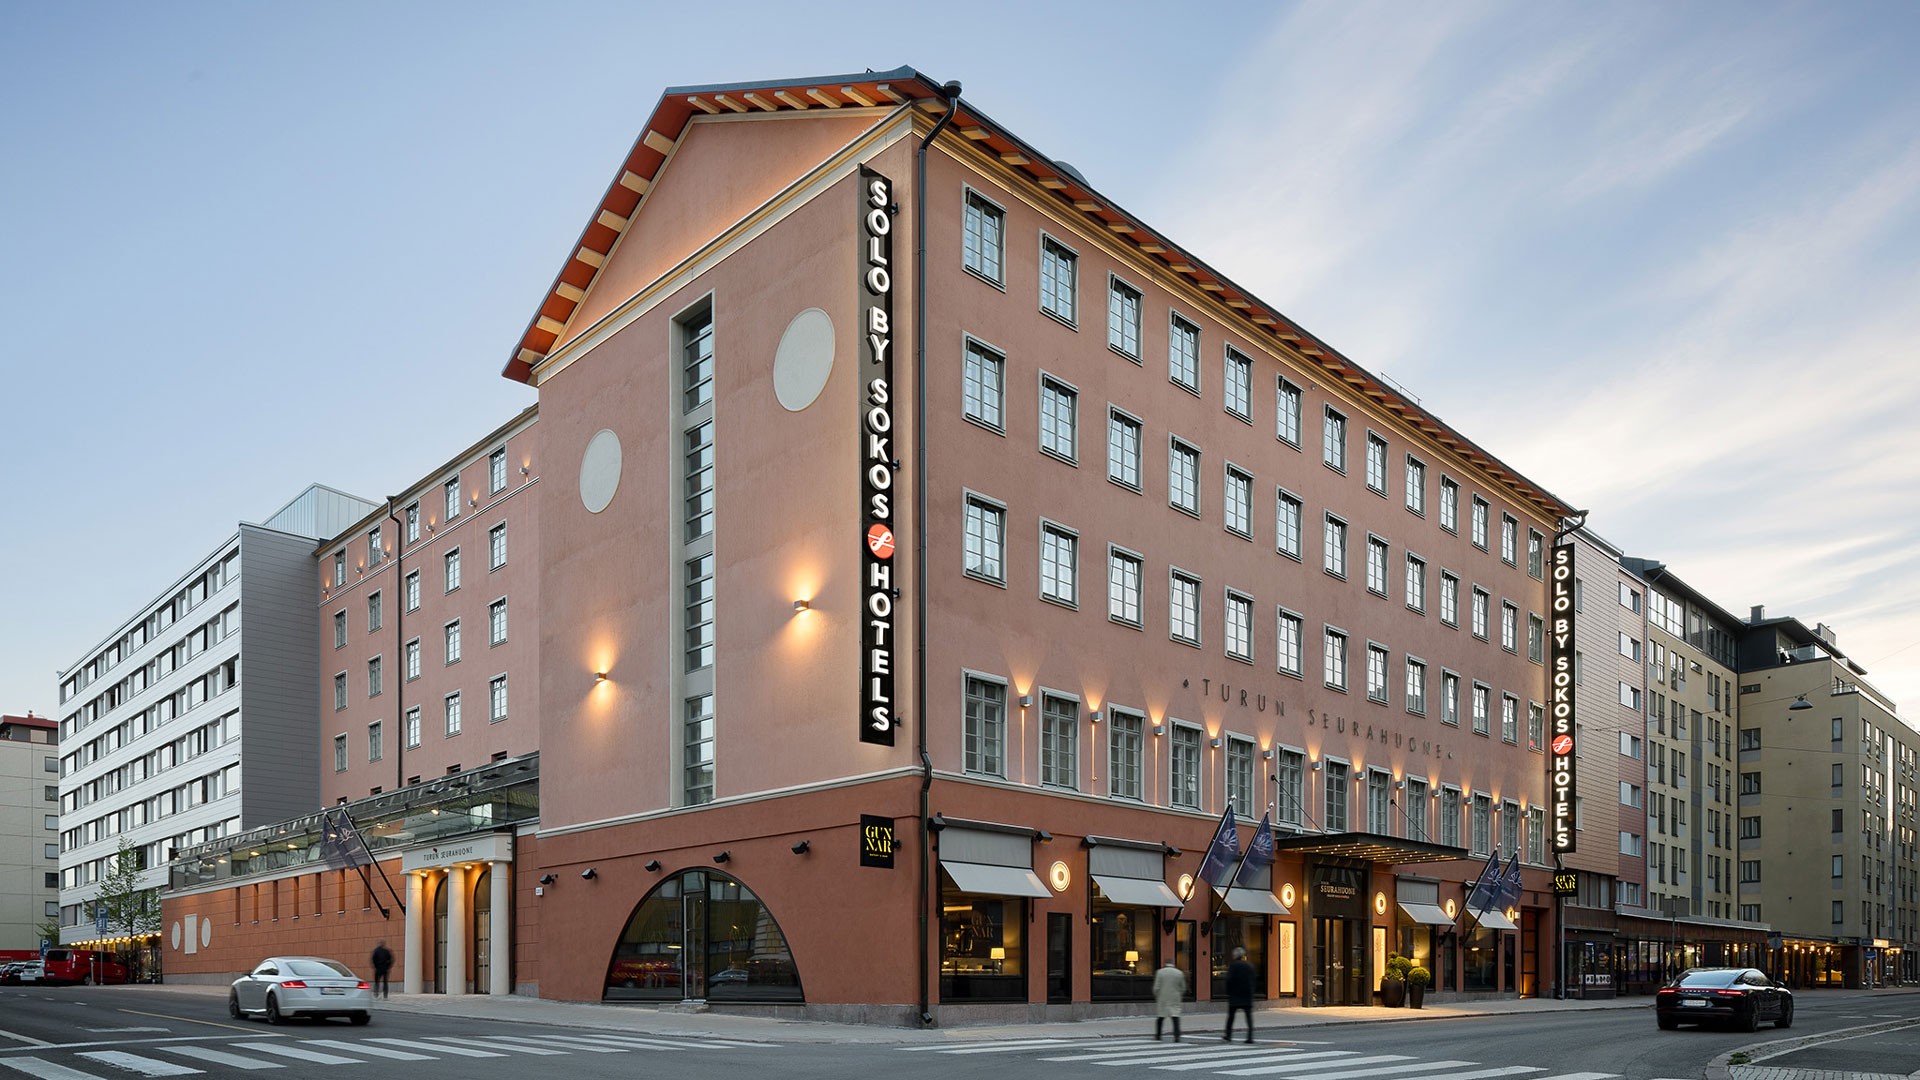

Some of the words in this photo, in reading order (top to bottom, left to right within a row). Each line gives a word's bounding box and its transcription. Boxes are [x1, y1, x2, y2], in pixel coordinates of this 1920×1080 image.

[867, 180, 890, 295] SOLO
[868, 306, 889, 362] BY
[867, 379, 891, 519] SOKOS
[1554, 550, 1570, 611] SOLO
[869, 562, 891, 732] HOTELS
[1555, 619, 1569, 649] BY
[1203, 678, 1285, 716] TURUN
[1308, 709, 1443, 759] SEURAHUONE
[1554, 656, 1570, 733] SOKOS
[1554, 756, 1570, 847] HOTELS
[865, 825, 892, 840] GUN
[866, 838, 892, 853] NAR
[1555, 874, 1576, 882] GUN
[1556, 881, 1576, 889] NAR
[97, 907, 106, 918] P
